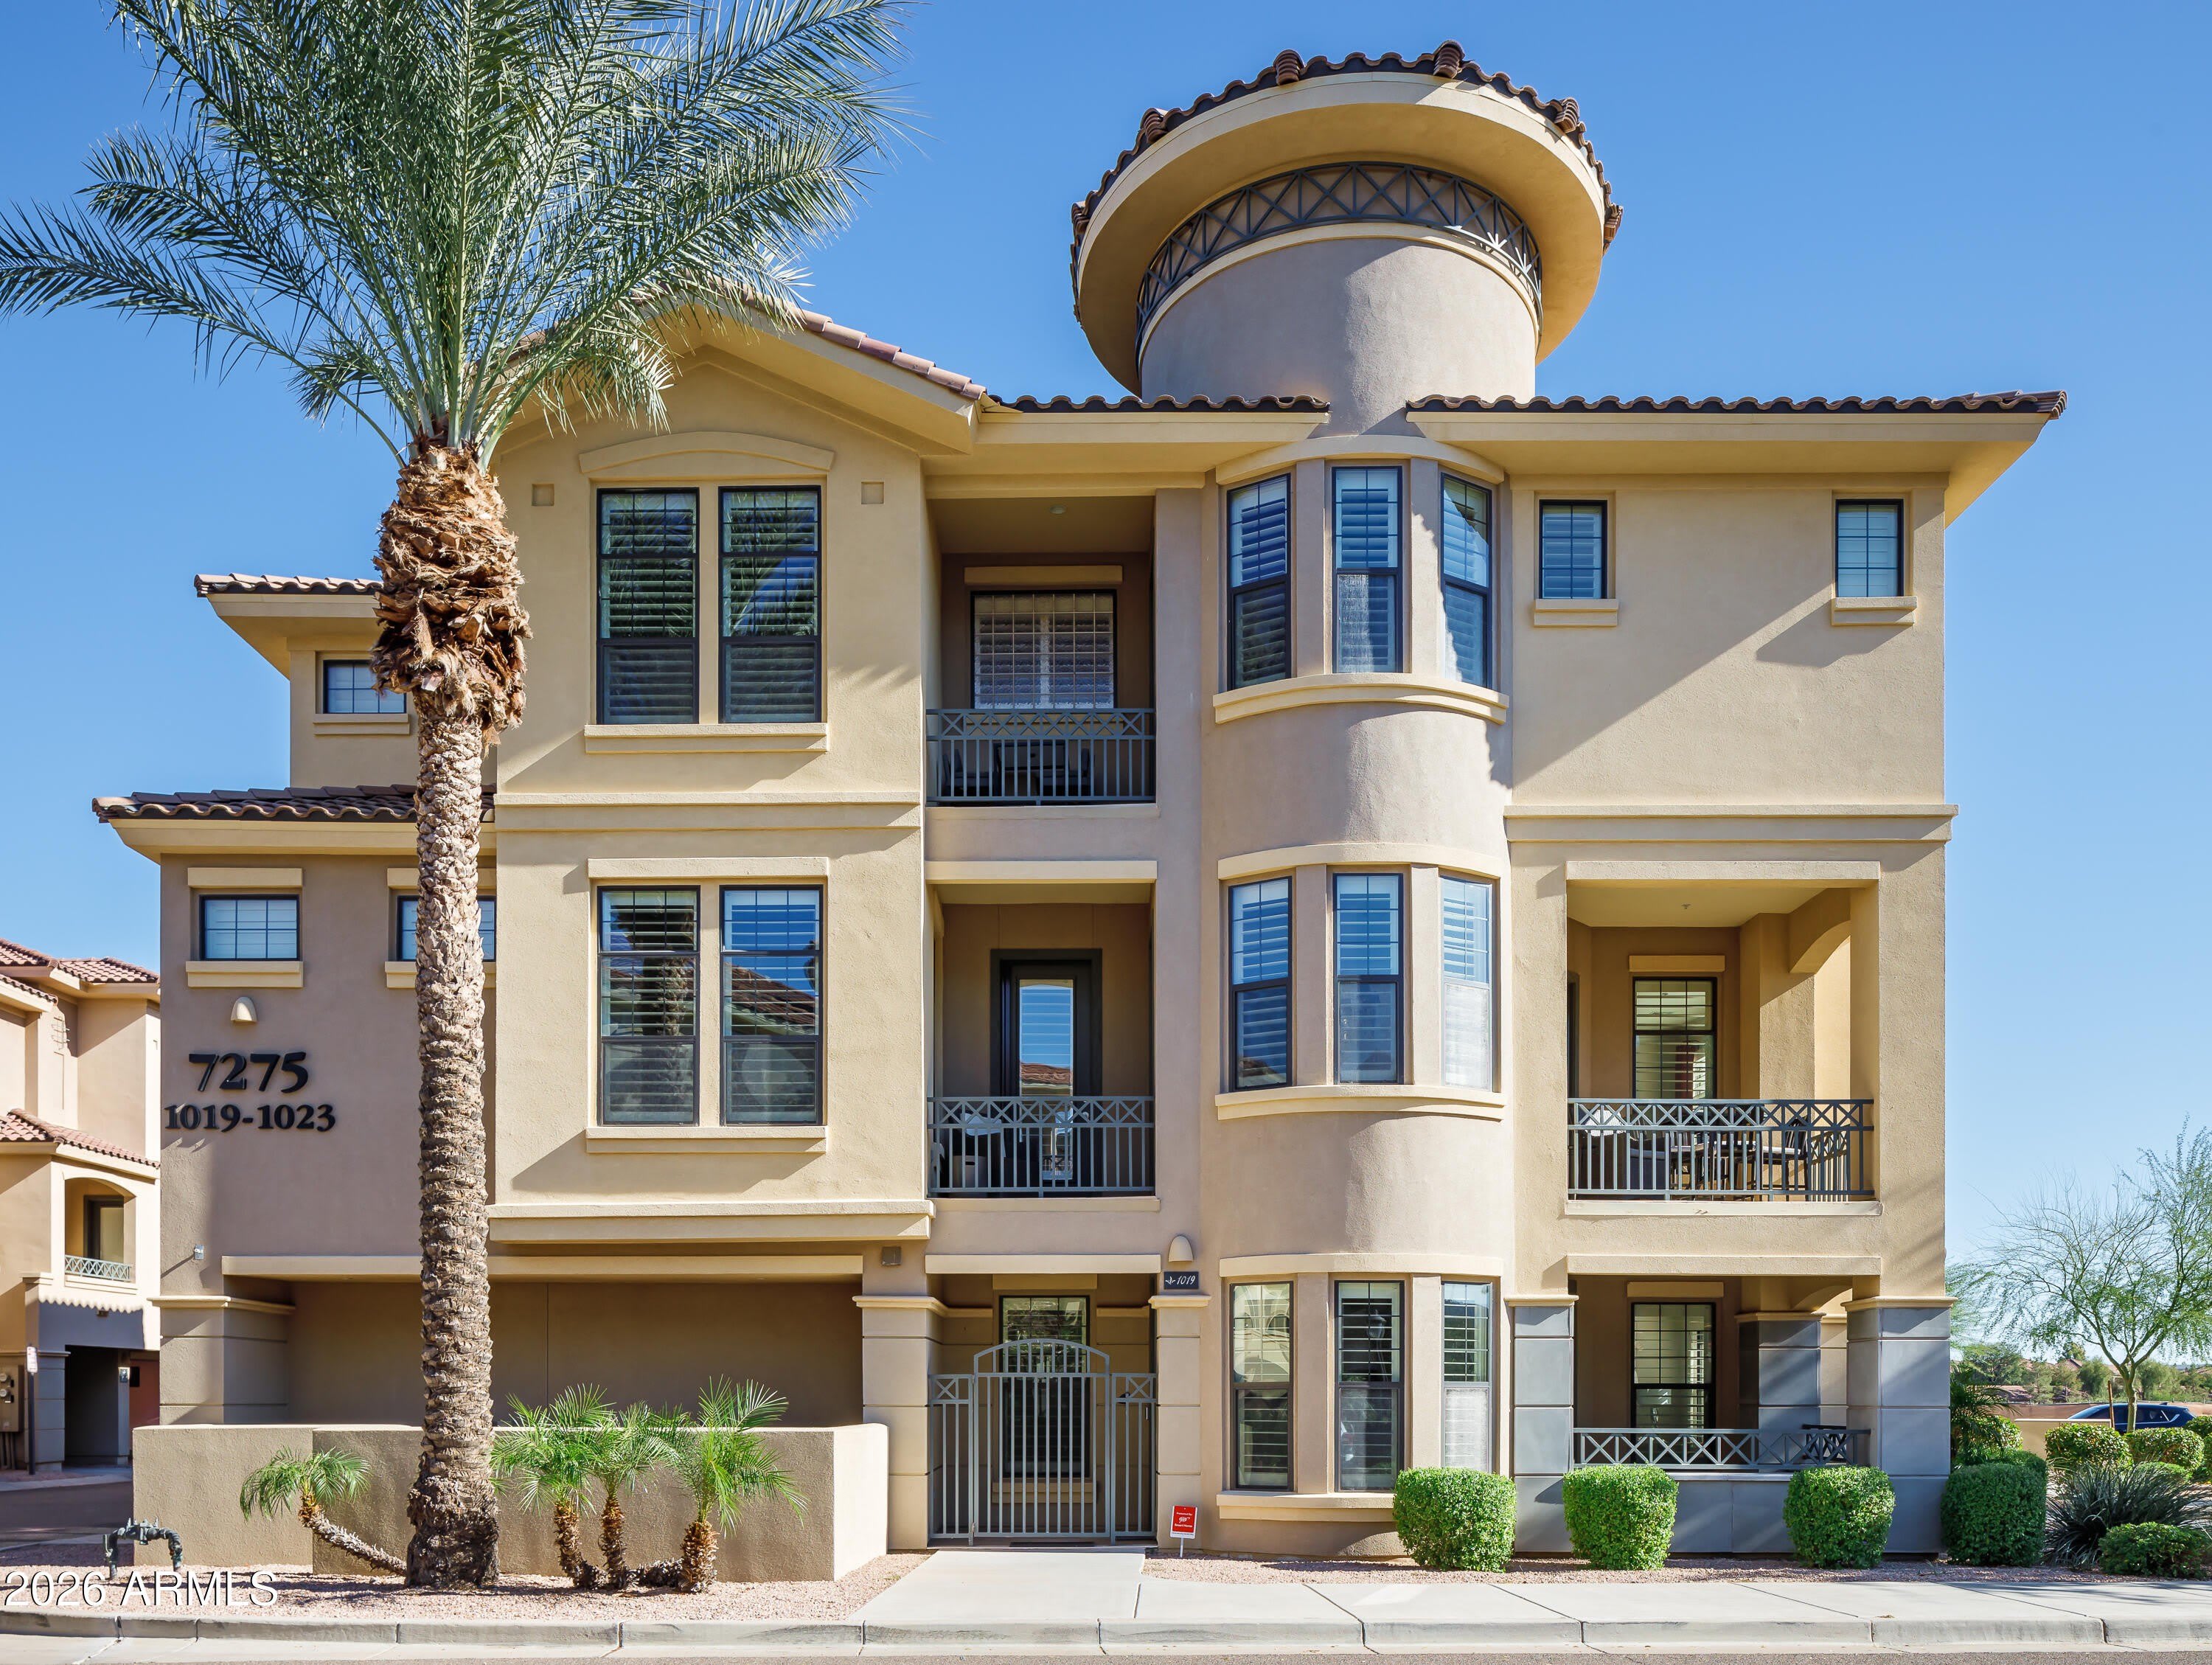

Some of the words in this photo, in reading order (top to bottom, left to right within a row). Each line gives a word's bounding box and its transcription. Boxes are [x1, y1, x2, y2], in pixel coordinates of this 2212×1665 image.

[189, 1052, 309, 1094] 7275
[164, 1104, 336, 1133] 1019-1023
[1177, 1276, 1196, 1285] 1019
